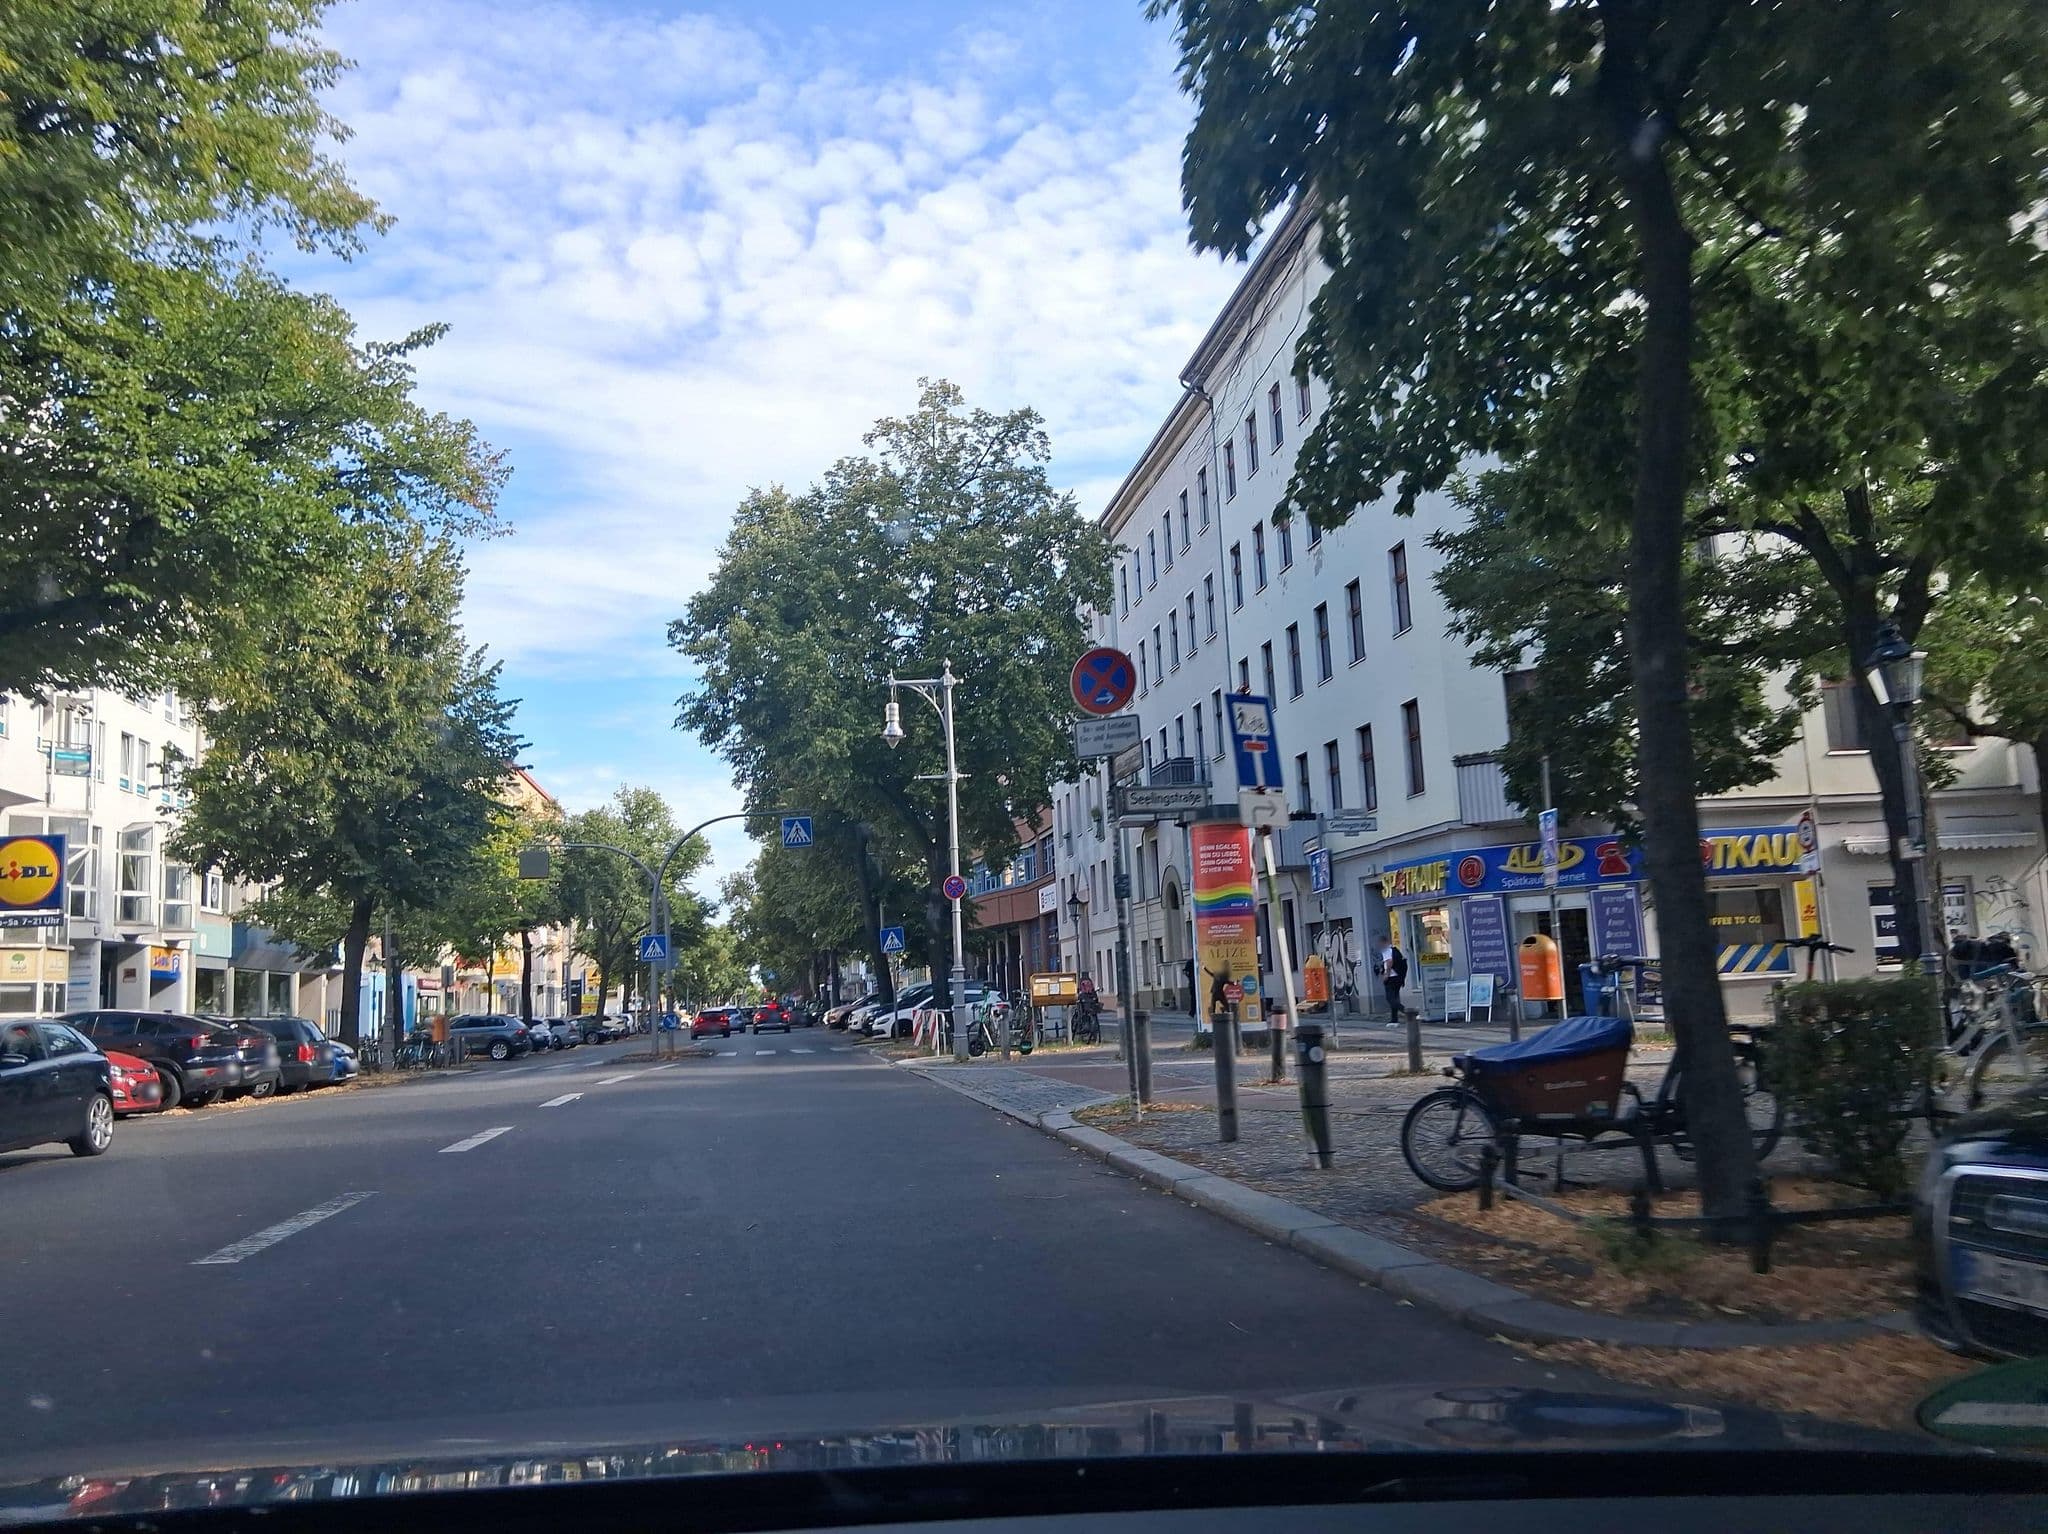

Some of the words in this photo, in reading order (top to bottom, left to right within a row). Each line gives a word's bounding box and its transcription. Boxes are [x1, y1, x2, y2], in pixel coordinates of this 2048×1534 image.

[1130, 790, 1202, 807] Seelingstraße
[1501, 874, 1544, 888] Spätkauf
[43, 917, 60, 925] Uhr
[1709, 916, 1732, 926] FFEE
[1734, 916, 1746, 925] TO
[1748, 915, 1761, 924] GO
